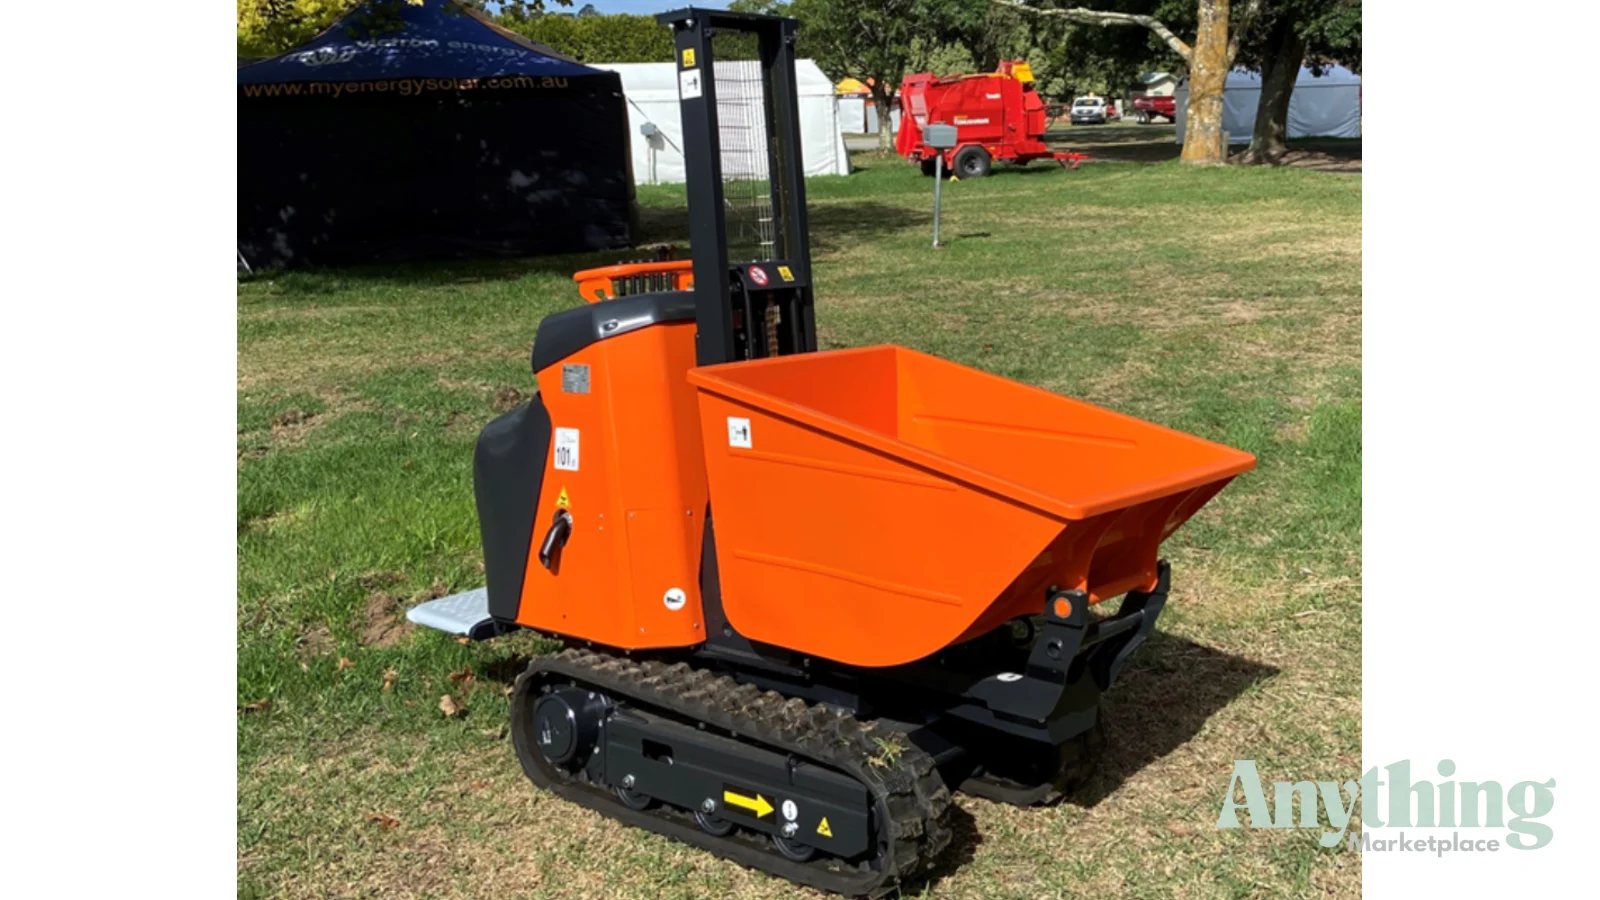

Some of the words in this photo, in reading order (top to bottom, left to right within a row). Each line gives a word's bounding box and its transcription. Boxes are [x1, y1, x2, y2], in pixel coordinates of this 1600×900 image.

[356, 37, 439, 48] victron
[447, 40, 529, 58] energy
[243, 75, 569, 98] www.myenergysolar.com.au
[556, 446, 571, 467] 101
